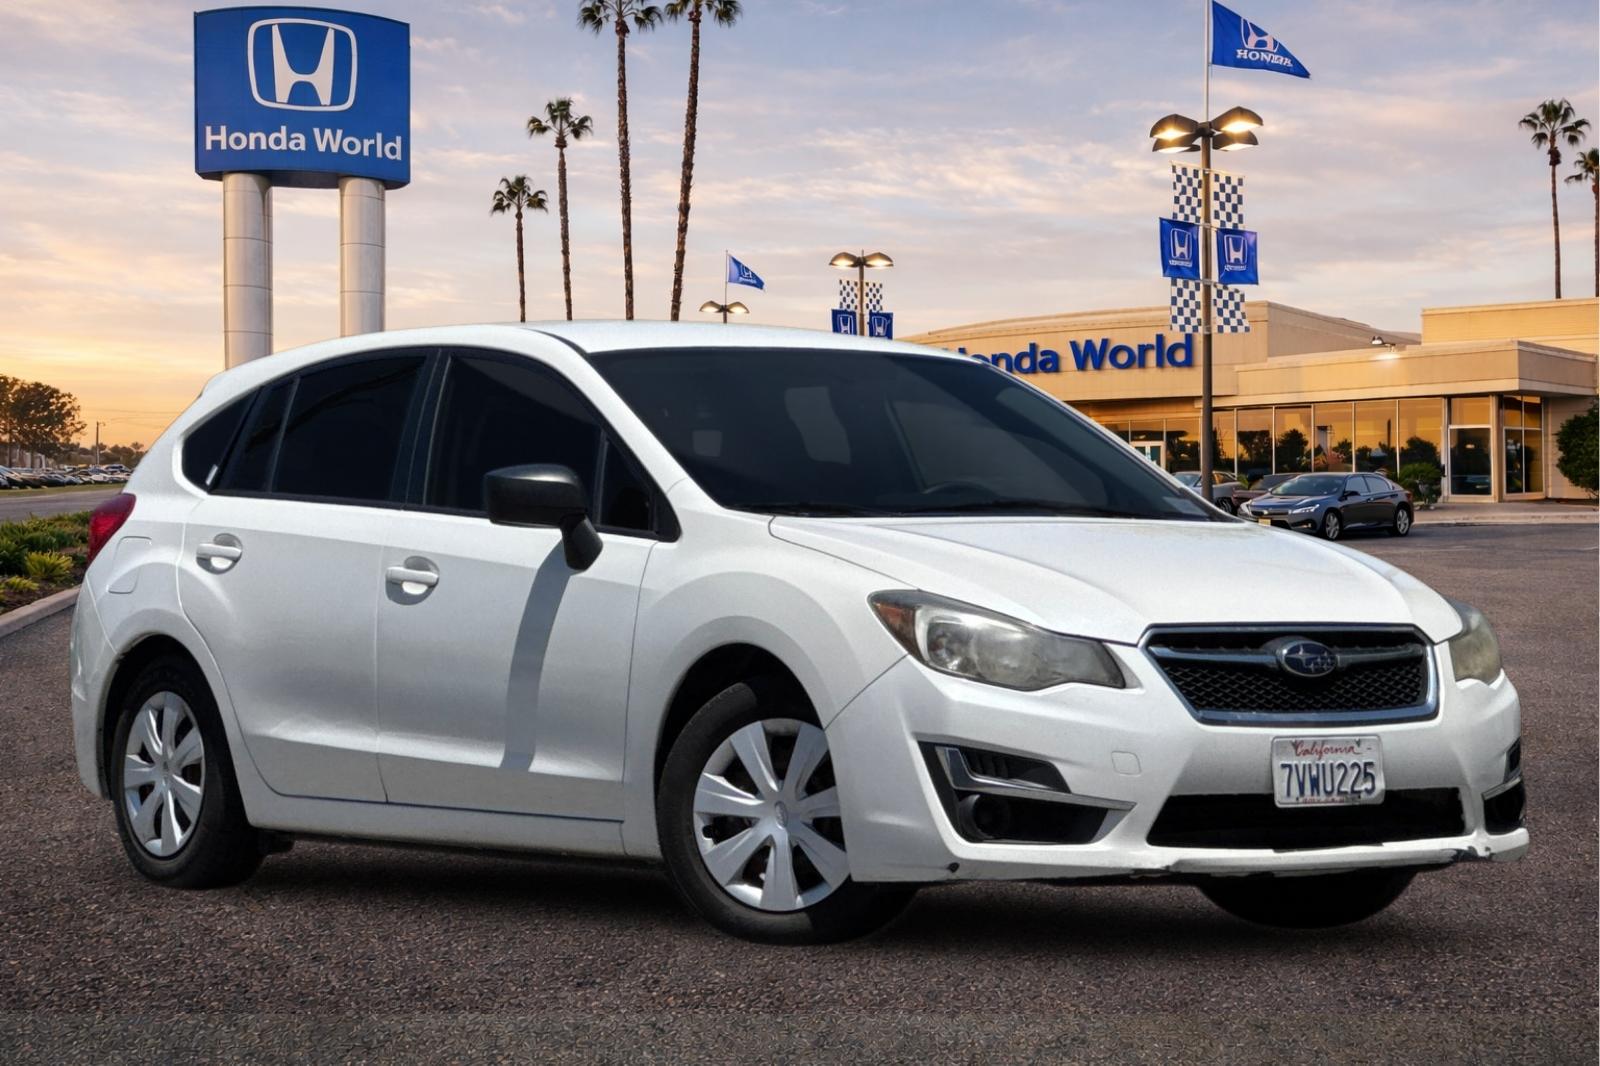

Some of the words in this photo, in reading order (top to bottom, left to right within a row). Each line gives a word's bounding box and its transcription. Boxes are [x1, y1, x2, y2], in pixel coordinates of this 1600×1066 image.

[205, 124, 306, 151] Honda
[312, 127, 403, 161] World
[950, 342, 1060, 375] nda
[1069, 333, 1194, 371] World
[1292, 740, 1362, 760] California
[1280, 761, 1376, 798] 7VWU225
